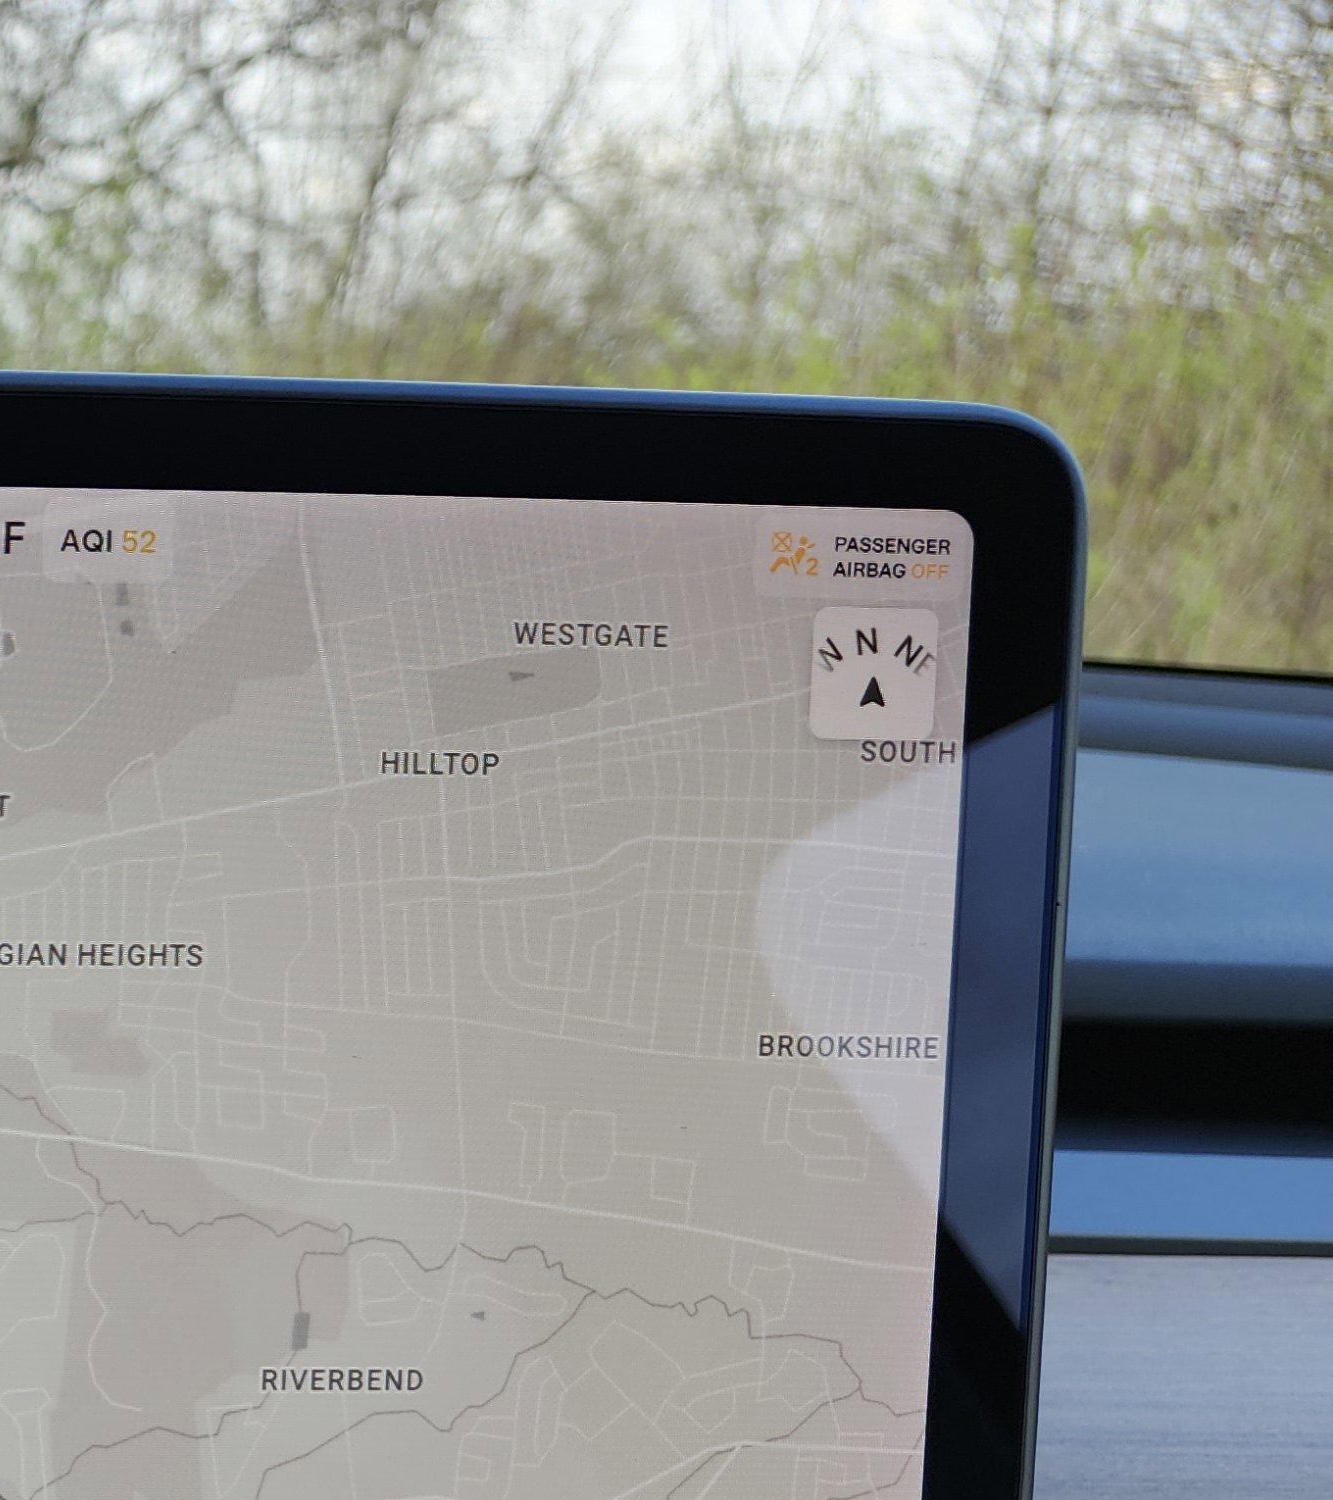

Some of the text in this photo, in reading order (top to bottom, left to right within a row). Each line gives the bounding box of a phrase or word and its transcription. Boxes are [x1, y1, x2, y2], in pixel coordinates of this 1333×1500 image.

[60, 528, 157, 556] AQI 52
[835, 536, 951, 555] PASSENGER
[833, 561, 949, 579] AIRBAG OFF
[514, 622, 668, 648] WESTGATE
[855, 627, 879, 656] N
[381, 751, 500, 776] HILLTOP
[859, 741, 959, 765] SOUTH
[77, 943, 204, 968] HEIGHTS
[758, 1034, 939, 1060] BROOKSHIRE
[261, 1368, 423, 1391] RIVERBEND
